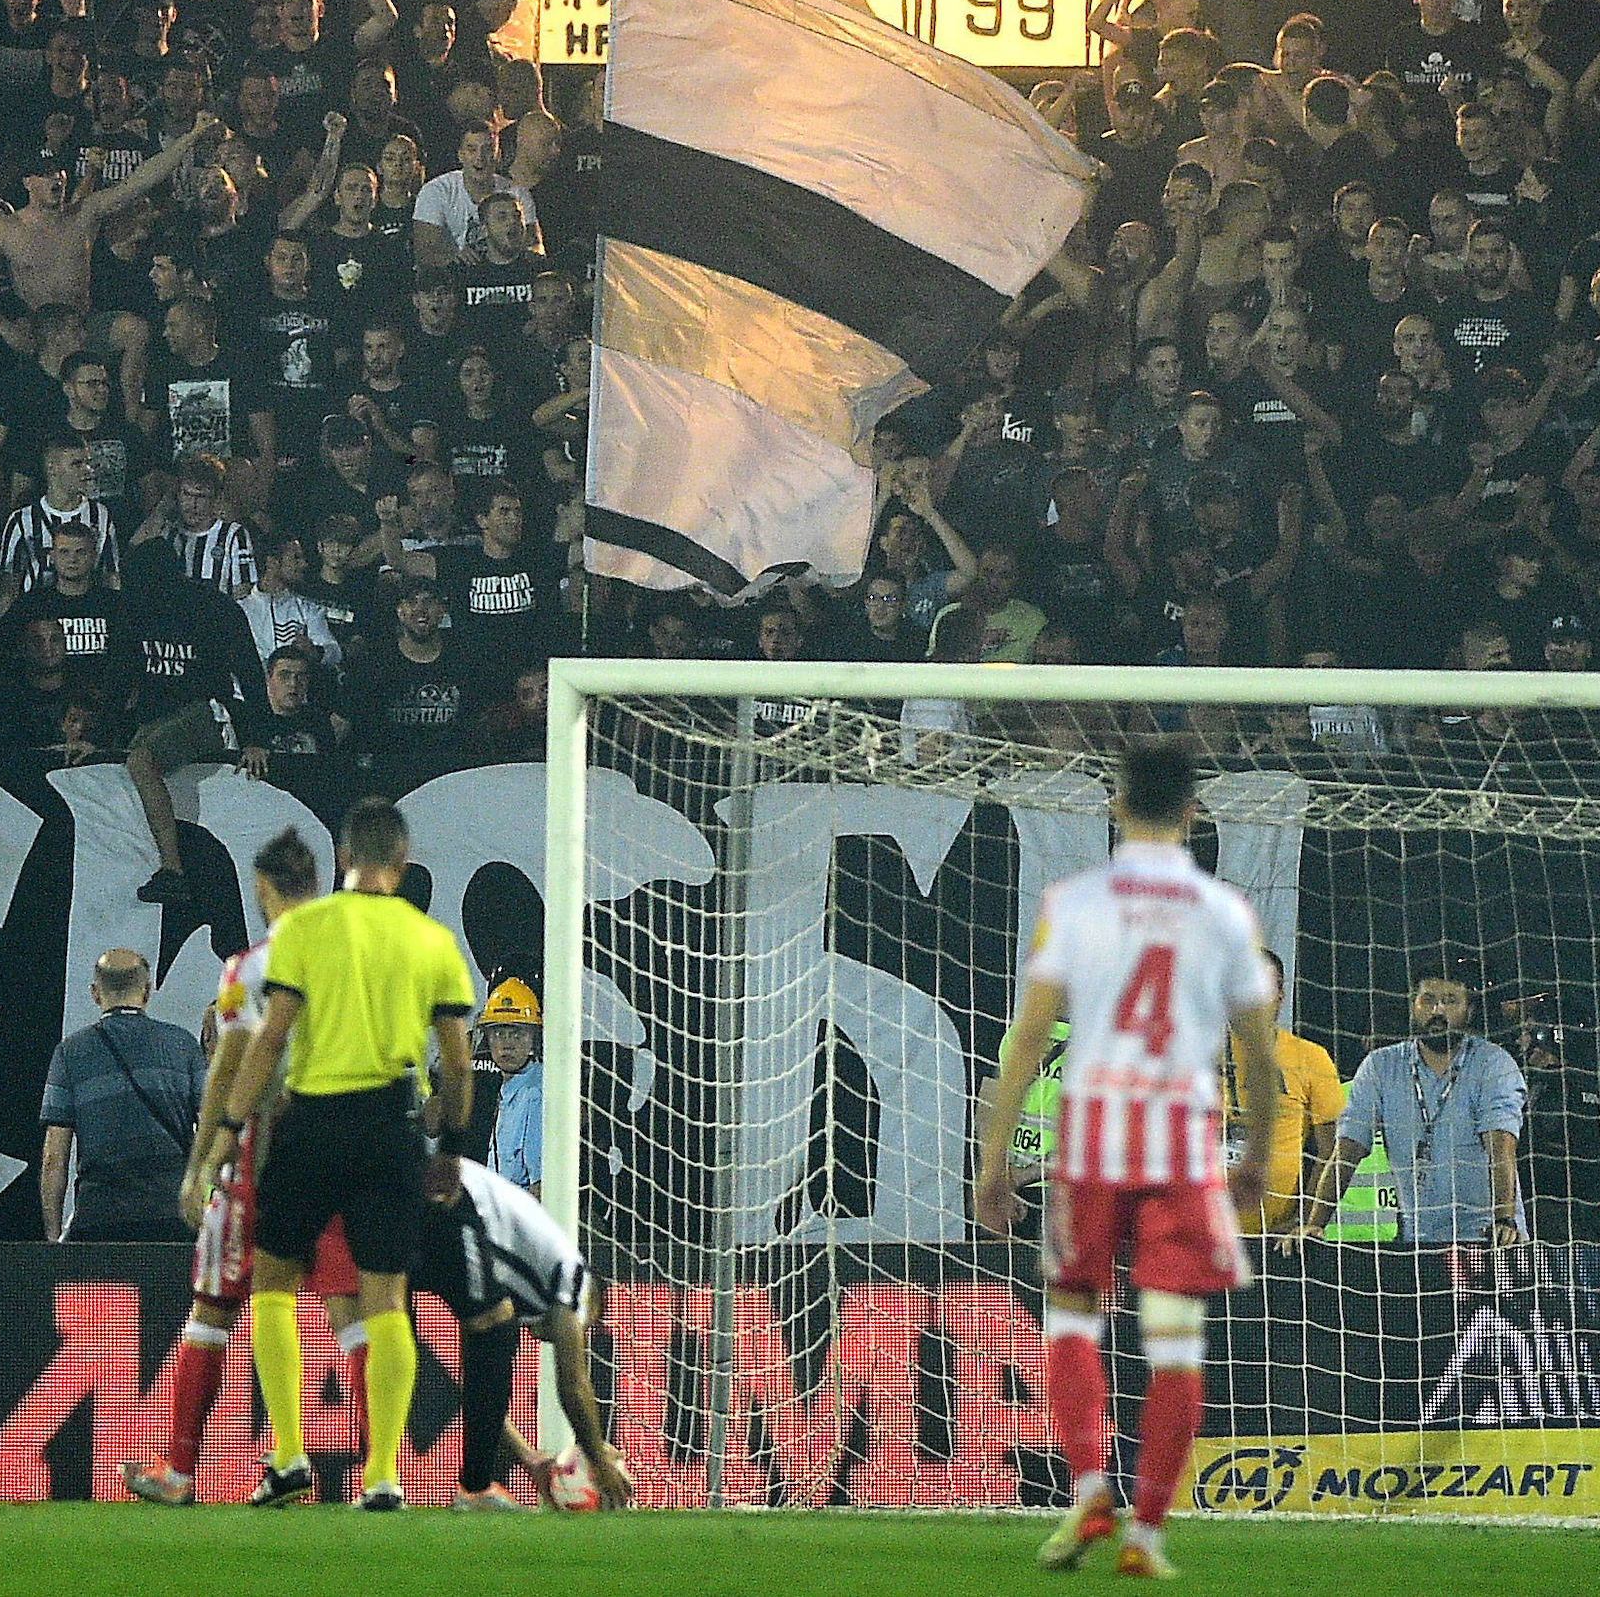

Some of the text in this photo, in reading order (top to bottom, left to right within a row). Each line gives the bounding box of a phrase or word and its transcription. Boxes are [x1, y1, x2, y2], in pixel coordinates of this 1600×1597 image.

[1113, 945, 1180, 1057] 4
[1013, 1126, 1043, 1153] 064
[1312, 1463, 1593, 1503] MOZZART
